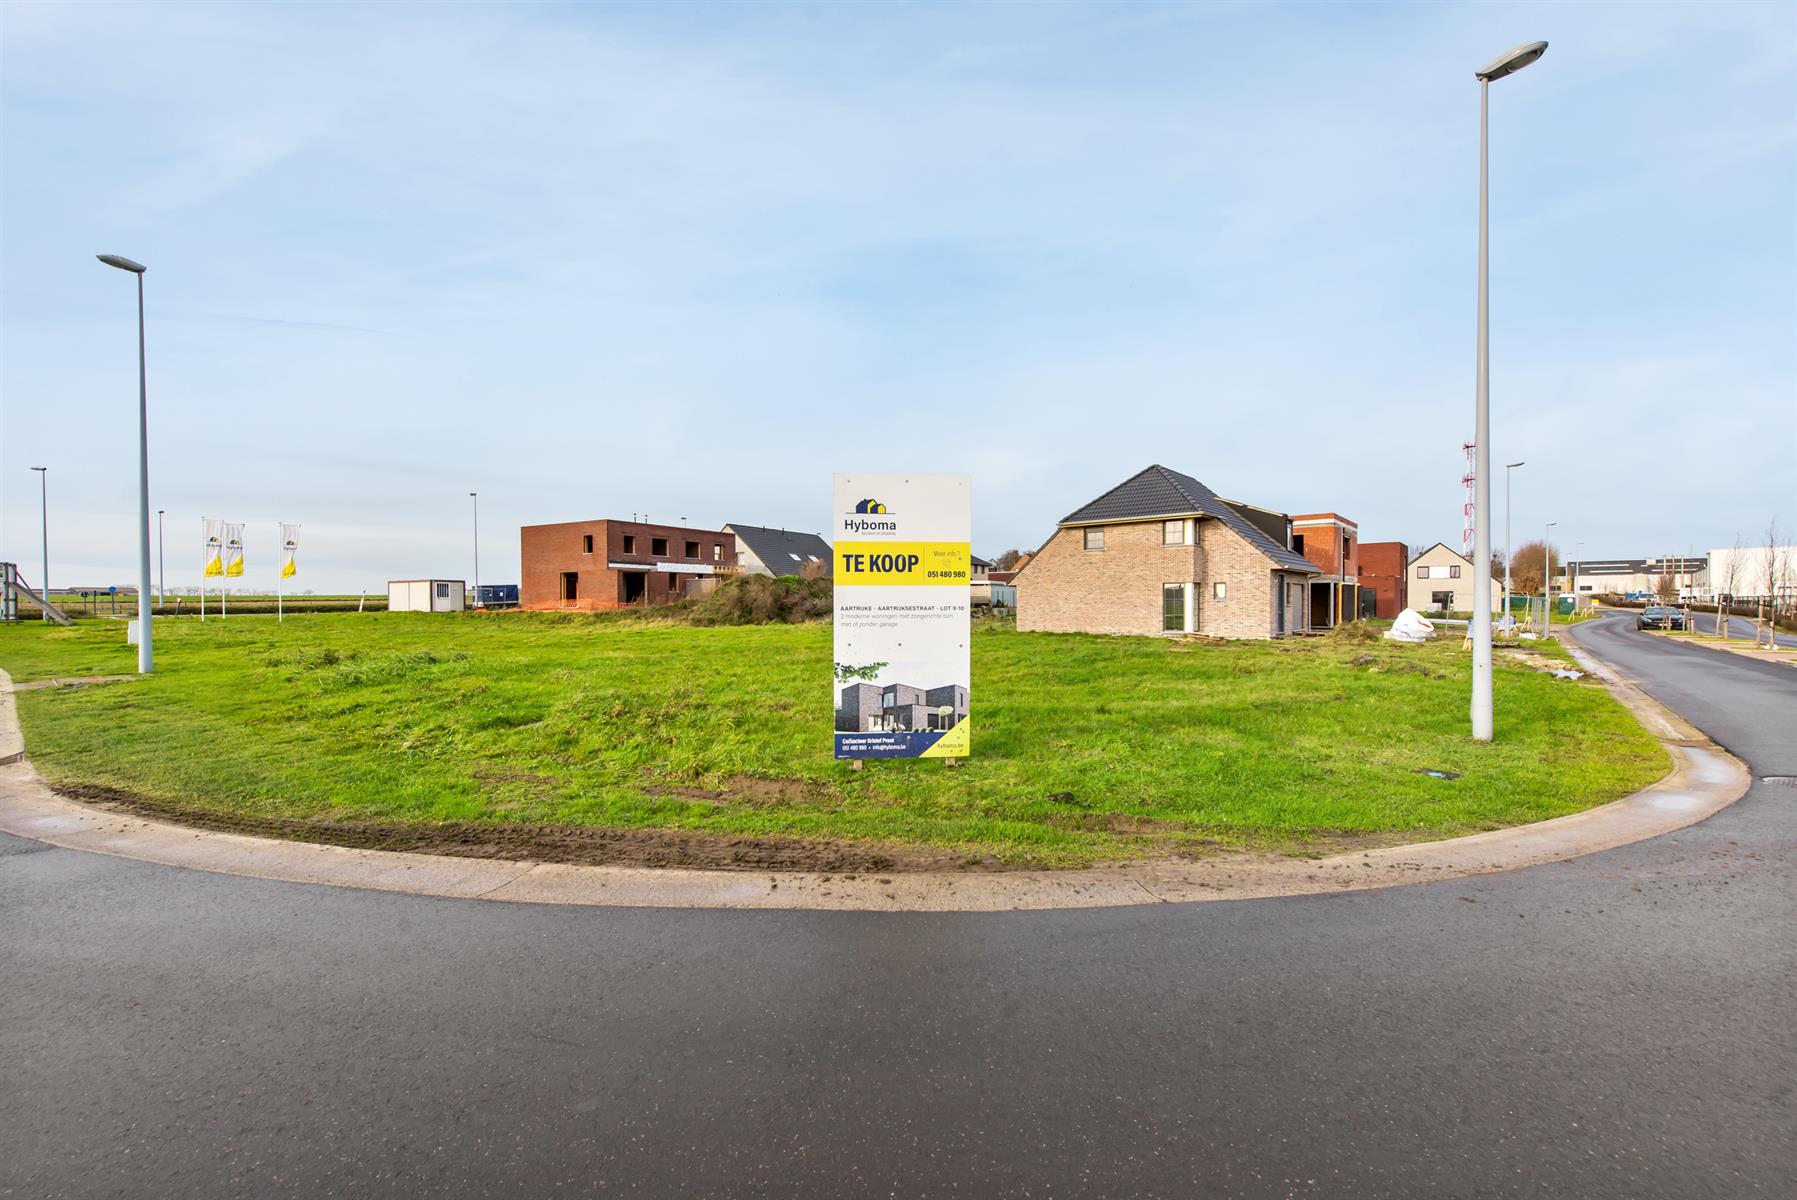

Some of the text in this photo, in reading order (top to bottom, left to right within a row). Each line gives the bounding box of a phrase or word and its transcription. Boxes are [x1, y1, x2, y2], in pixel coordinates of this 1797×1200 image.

[844, 520, 896, 532] Hyboma
[842, 554, 920, 572] TE KOOP
